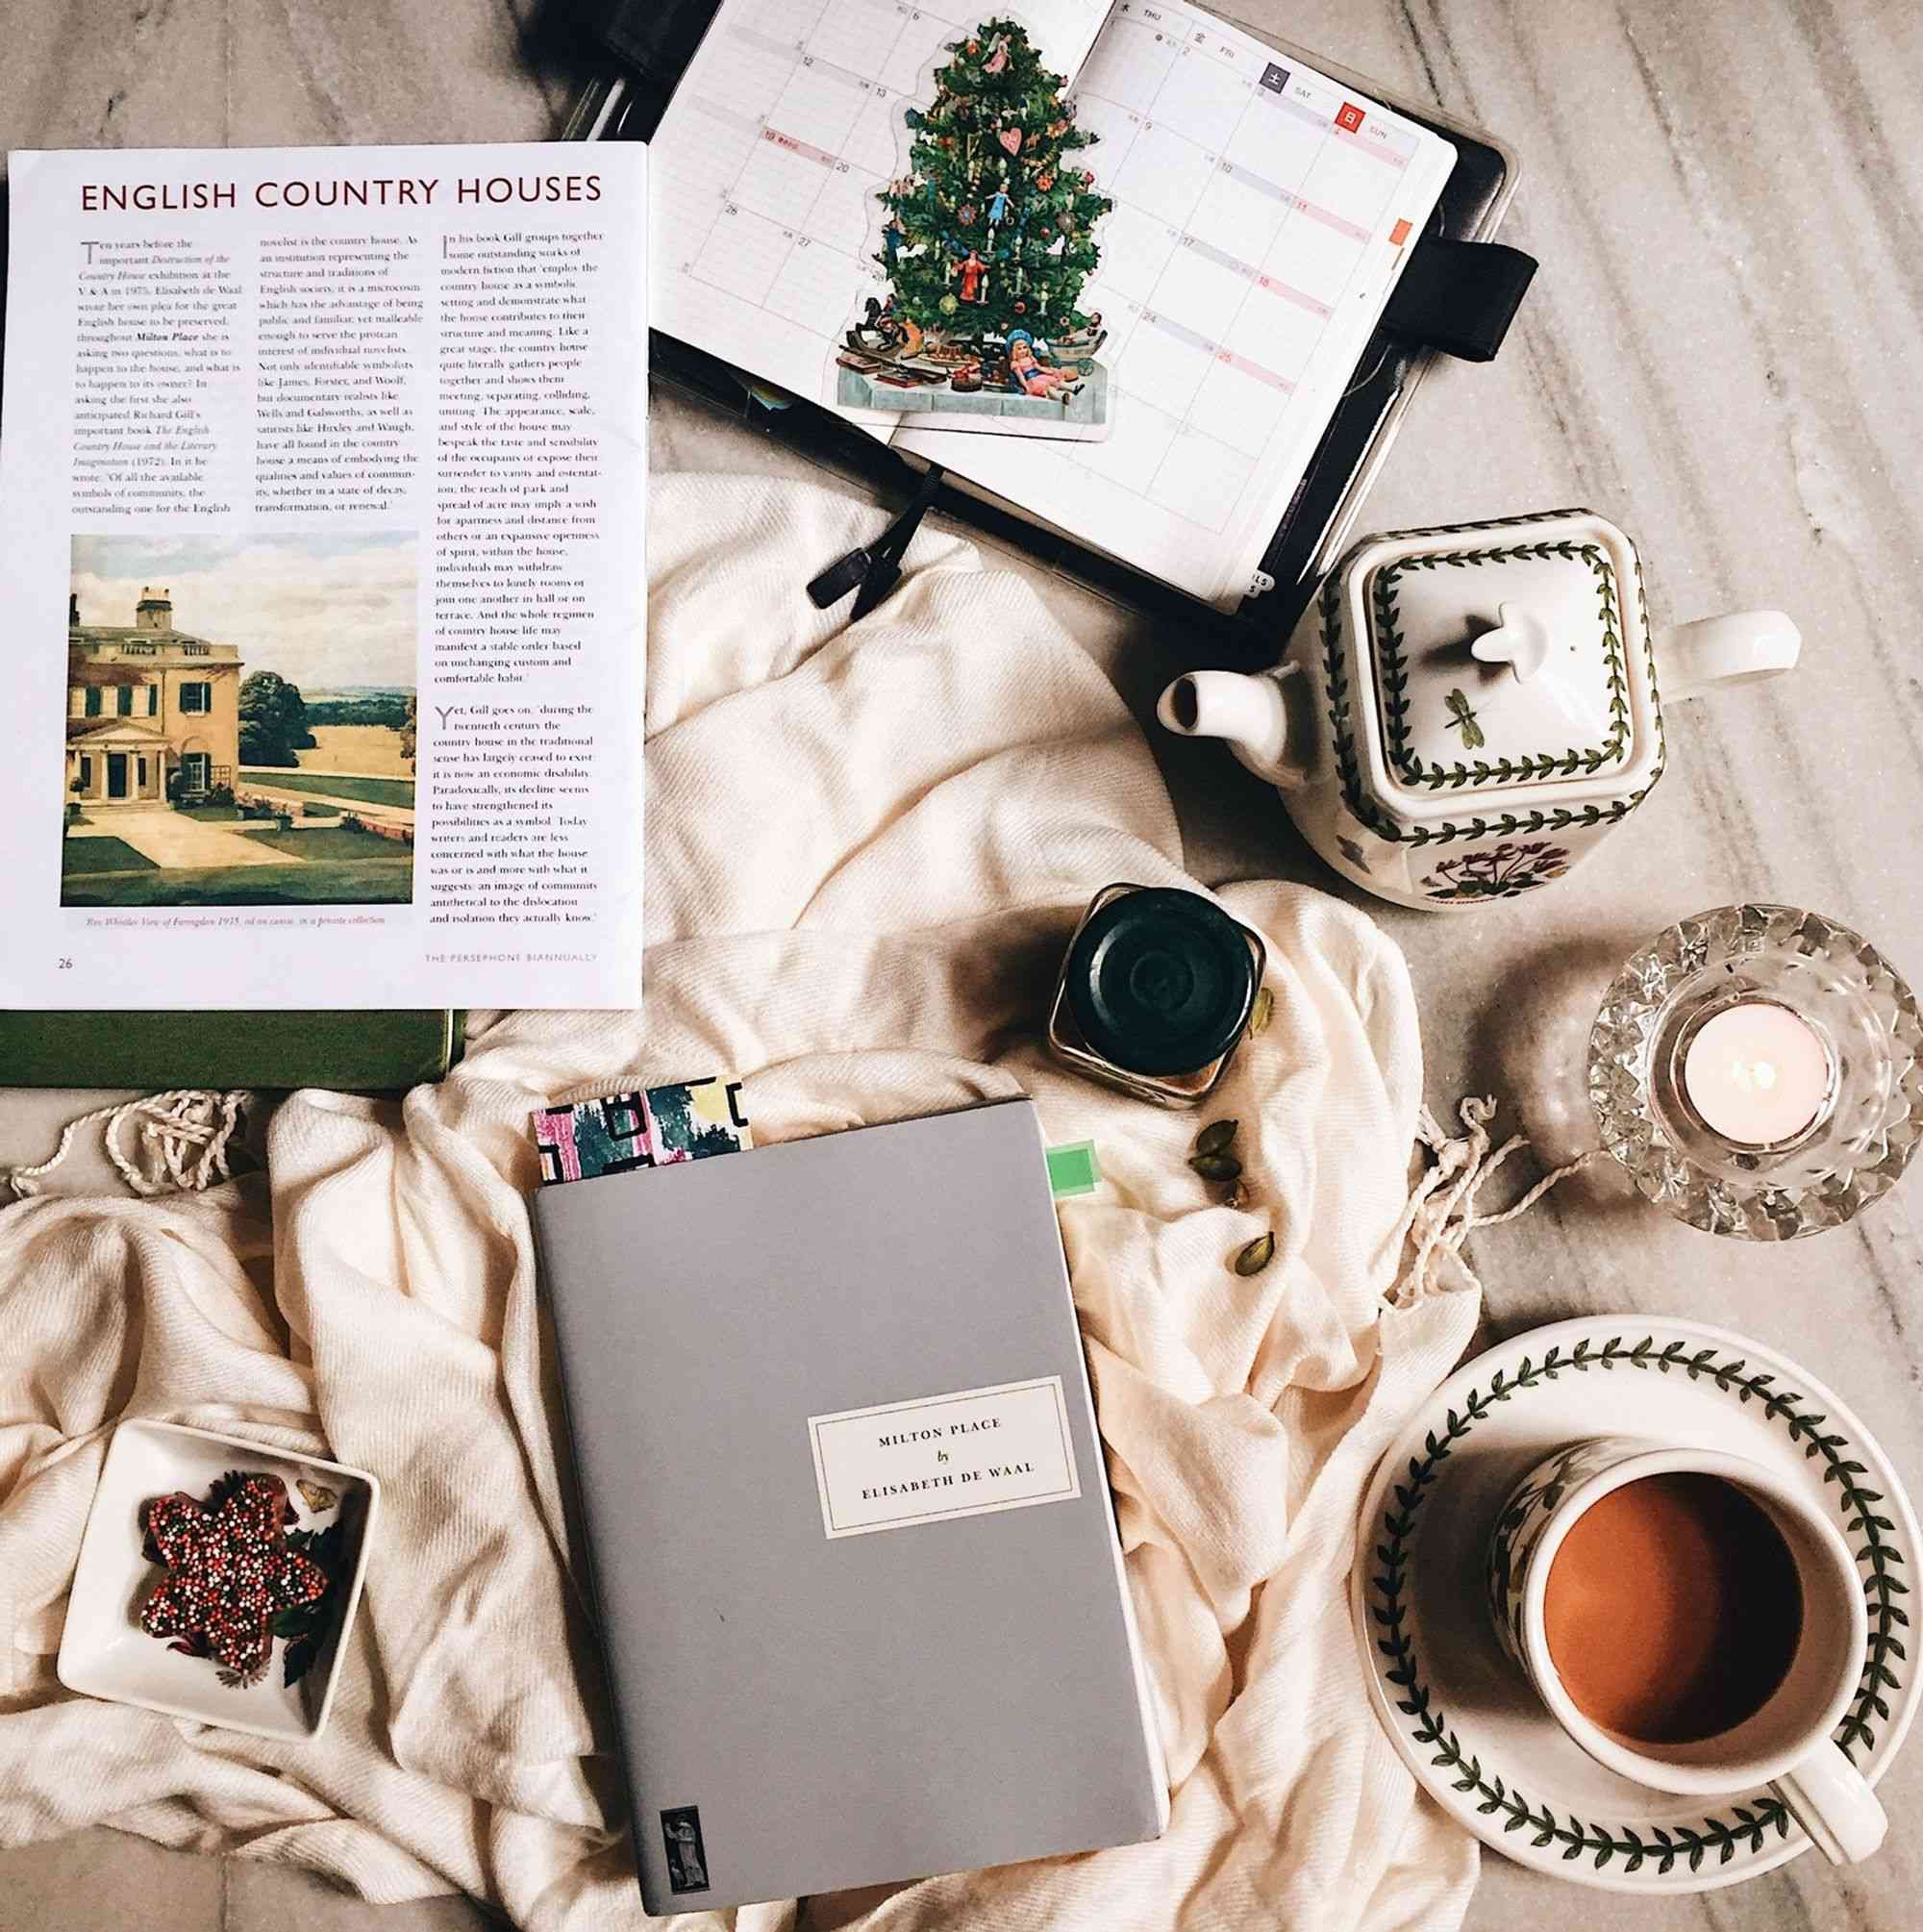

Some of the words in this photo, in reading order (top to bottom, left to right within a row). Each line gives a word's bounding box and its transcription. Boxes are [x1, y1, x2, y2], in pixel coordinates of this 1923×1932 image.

[802, 56, 814, 67] 12
[1269, 72, 1282, 87] 土
[876, 88, 887, 98] 13
[1344, 112, 1357, 124] 日
[836, 162, 850, 173] 20
[82, 184, 235, 211] ENGLISH
[256, 180, 438, 207] COUNTRY
[458, 176, 601, 203] HOUSES
[798, 236, 812, 248] 27
[59, 959, 72, 969] 26
[425, 954, 446, 963] THE
[450, 954, 520, 963] PERSEPHONE
[527, 953, 597, 963] BIANNUALLY
[879, 1427, 943, 1447] MILTON
[951, 1418, 1001, 1436] PLACE
[937, 1450, 950, 1464] by
[862, 1476, 954, 1499] ELISABETH
[962, 1470, 982, 1483] DE
[989, 1462, 1035, 1478] WAAL
